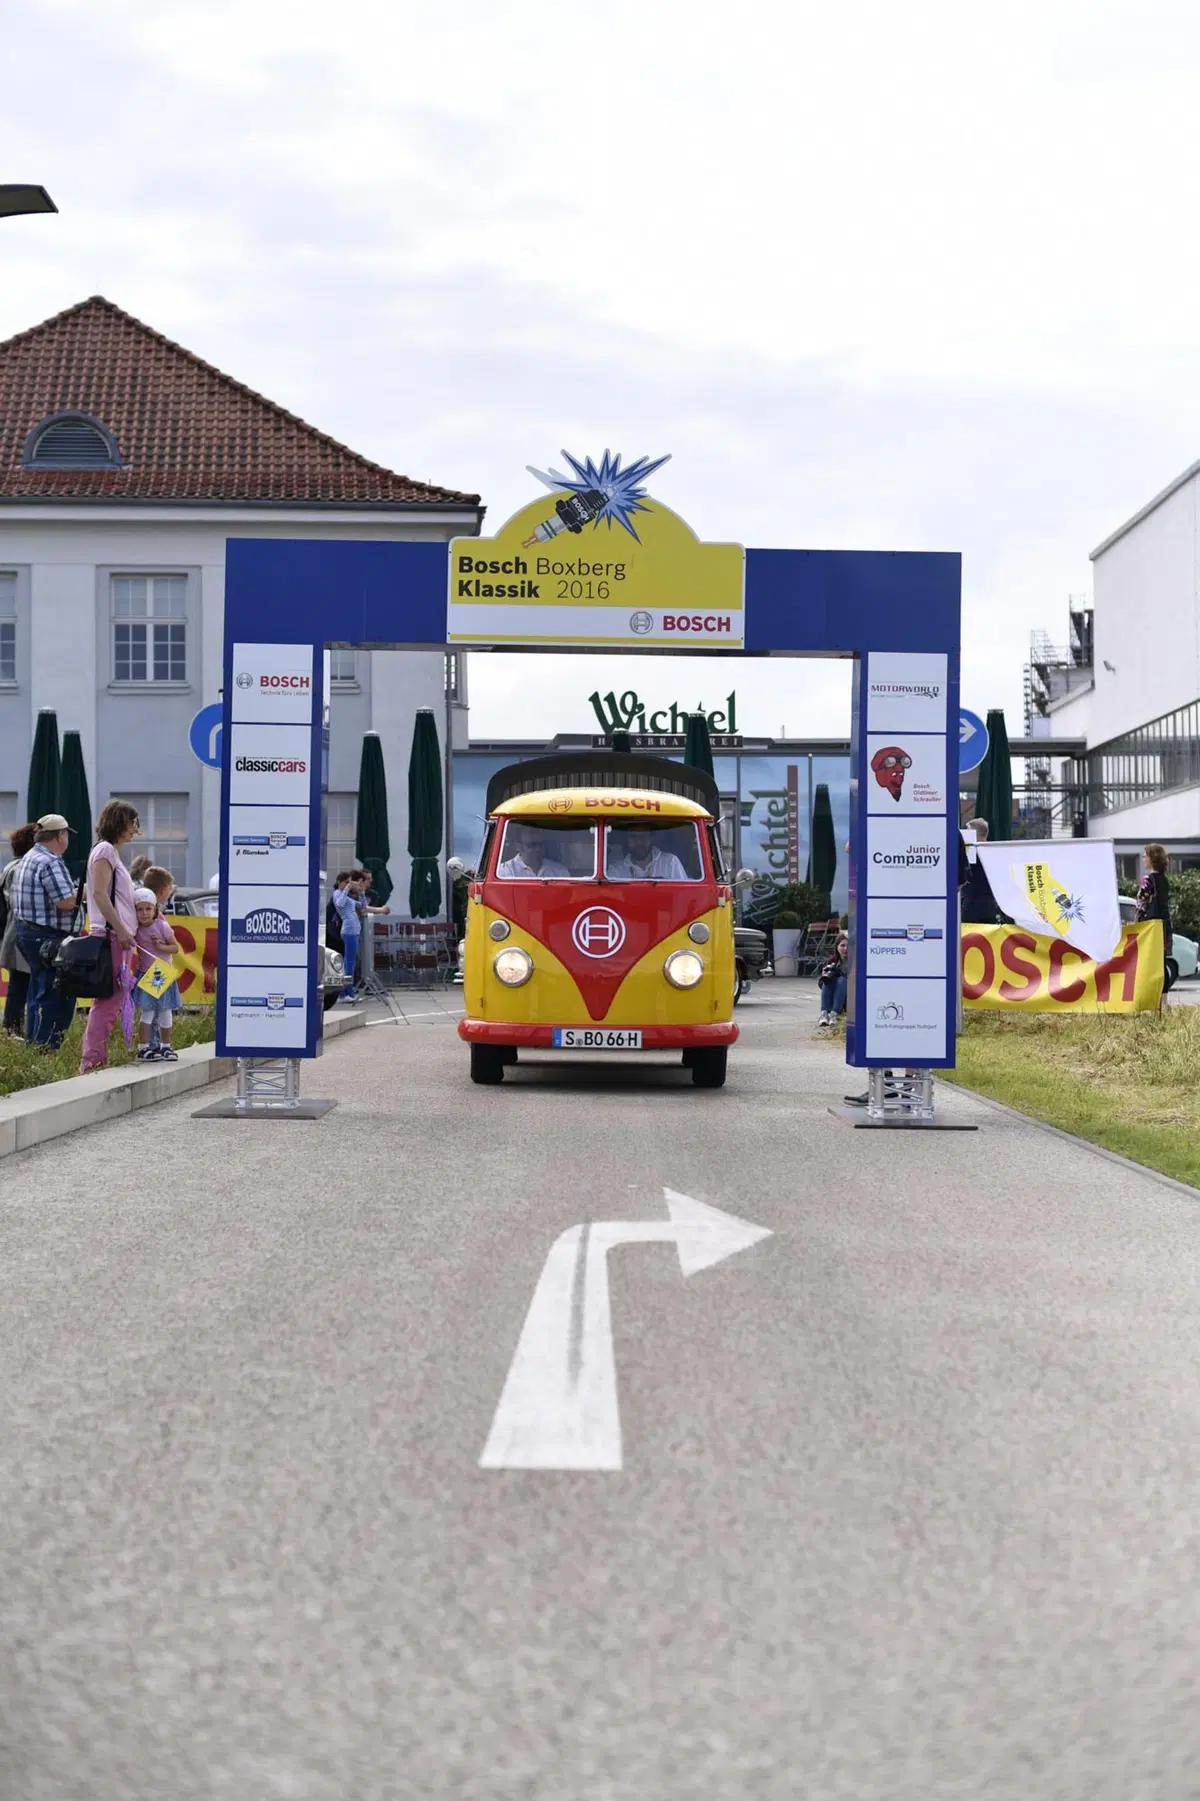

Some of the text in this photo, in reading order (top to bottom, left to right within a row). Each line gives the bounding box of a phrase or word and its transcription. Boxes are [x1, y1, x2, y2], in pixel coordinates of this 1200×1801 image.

[571, 497, 590, 521] BOSCH
[458, 556, 627, 581] Bosch Boxberg
[458, 580, 610, 599] Klassik 2016
[663, 615, 731, 632] BOSCH
[259, 675, 310, 688] BOSCH
[871, 684, 940, 693] MOTORWORLD
[588, 690, 740, 735] Wichel
[598, 737, 739, 746] HSBRAREI
[235, 756, 306, 773] classiccars
[584, 796, 661, 812] BOSCH
[906, 844, 941, 854] Junior
[873, 852, 941, 867] Company
[1026, 865, 1037, 894] Klassik
[1035, 864, 1045, 889] Bosch
[245, 911, 291, 934] BOXBERG
[565, 1031, 575, 1046] S
